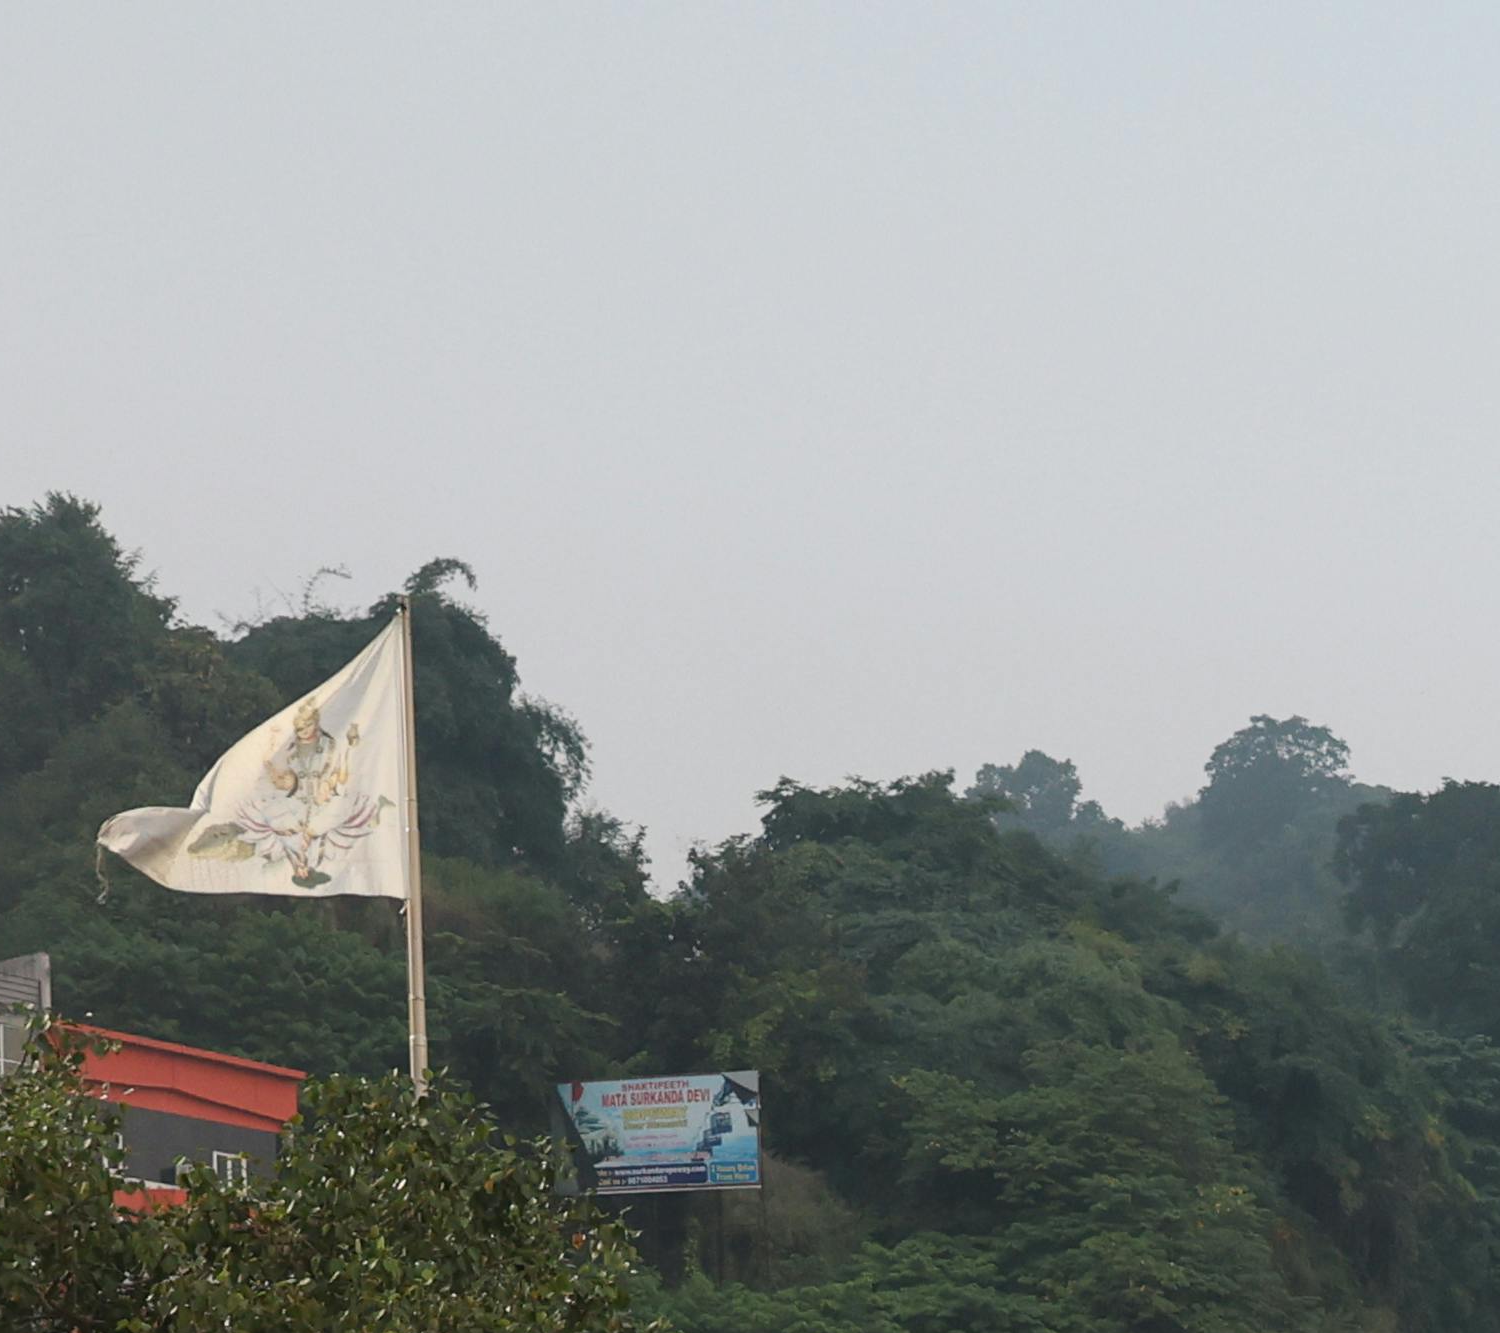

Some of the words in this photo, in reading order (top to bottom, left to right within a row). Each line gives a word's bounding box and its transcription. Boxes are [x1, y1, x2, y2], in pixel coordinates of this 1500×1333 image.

[602, 1094, 628, 1108] MATA
[630, 1091, 685, 1106] SURKANDA
[687, 1089, 711, 1103] DEVI
